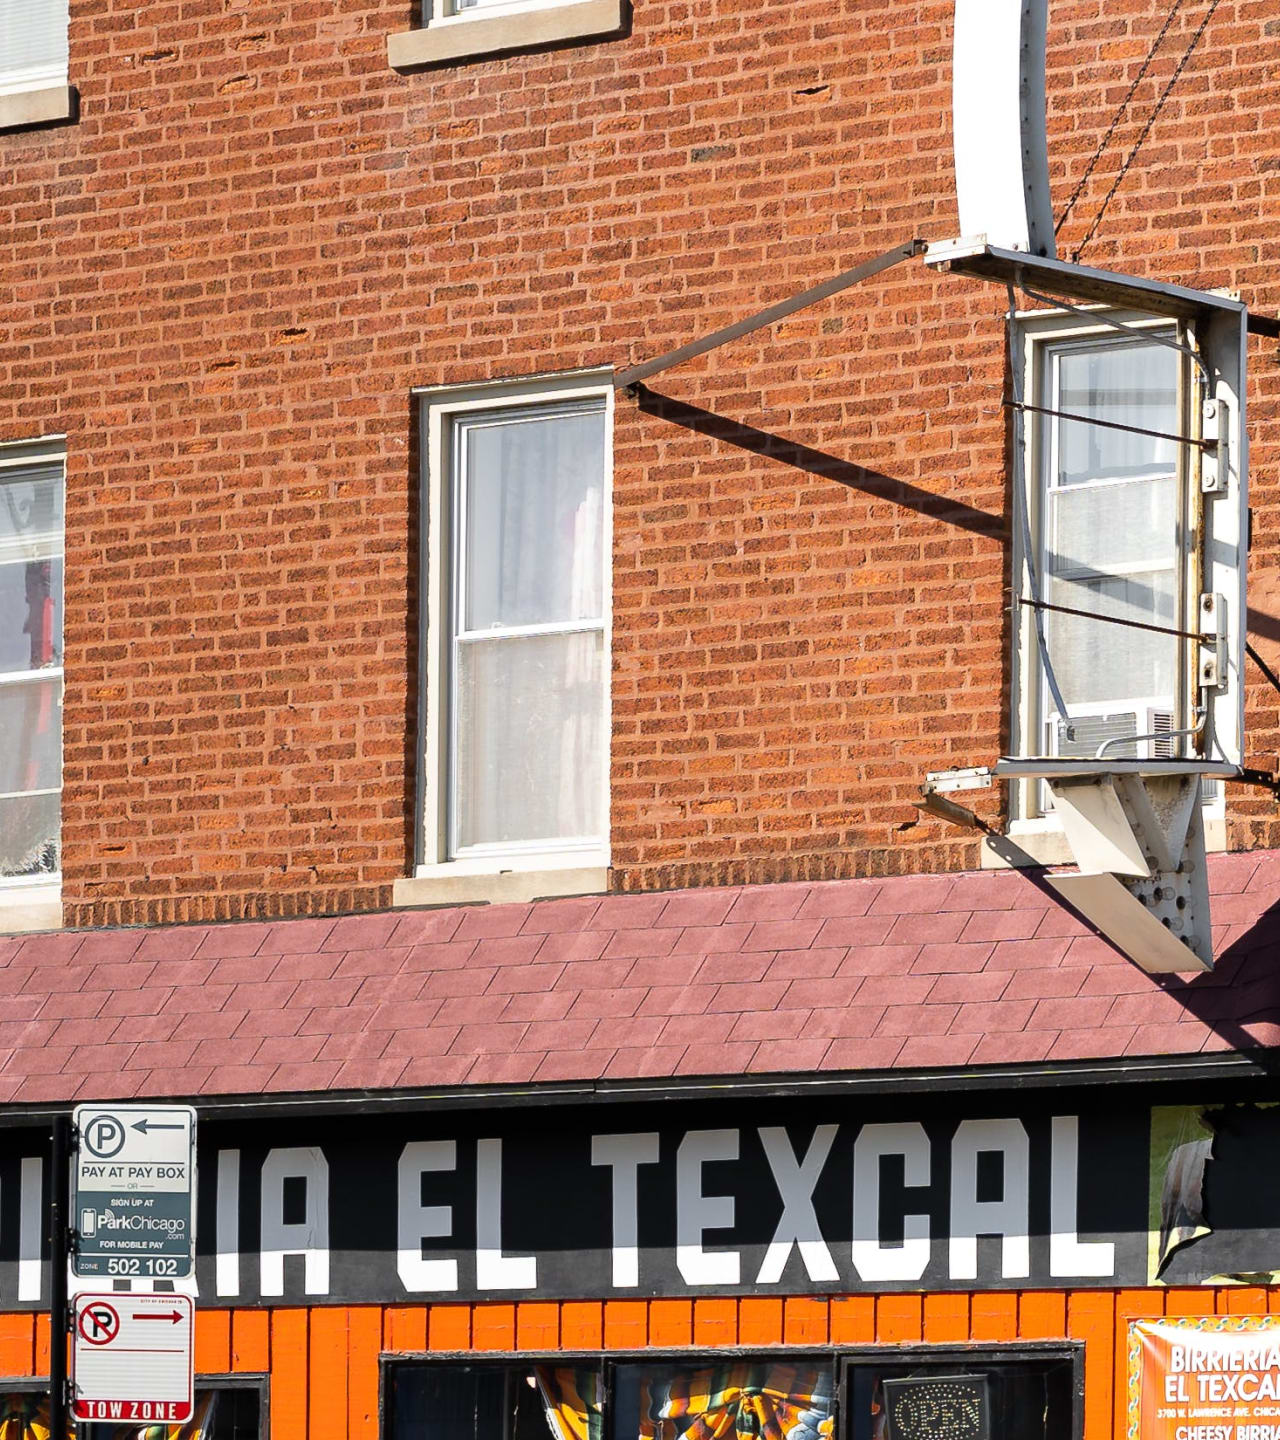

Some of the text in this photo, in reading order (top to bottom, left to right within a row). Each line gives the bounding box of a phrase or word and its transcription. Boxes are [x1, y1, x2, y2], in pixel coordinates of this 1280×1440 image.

[82, 1166, 185, 1179] PAY AT PAY BOX
[110, 1198, 130, 1206] SIGN
[144, 1199, 154, 1207] AT
[397, 1138, 538, 1292] EL
[591, 1115, 1115, 1287] TEXCAL
[97, 1214, 185, 1234] ParkChicago
[100, 1240, 116, 1248] FOR
[149, 1241, 164, 1249] PAY
[108, 1258, 140, 1275] 502
[146, 1258, 178, 1275] 102
[1164, 1375, 1190, 1402] EL
[86, 1401, 177, 1420] TOW ZONE
